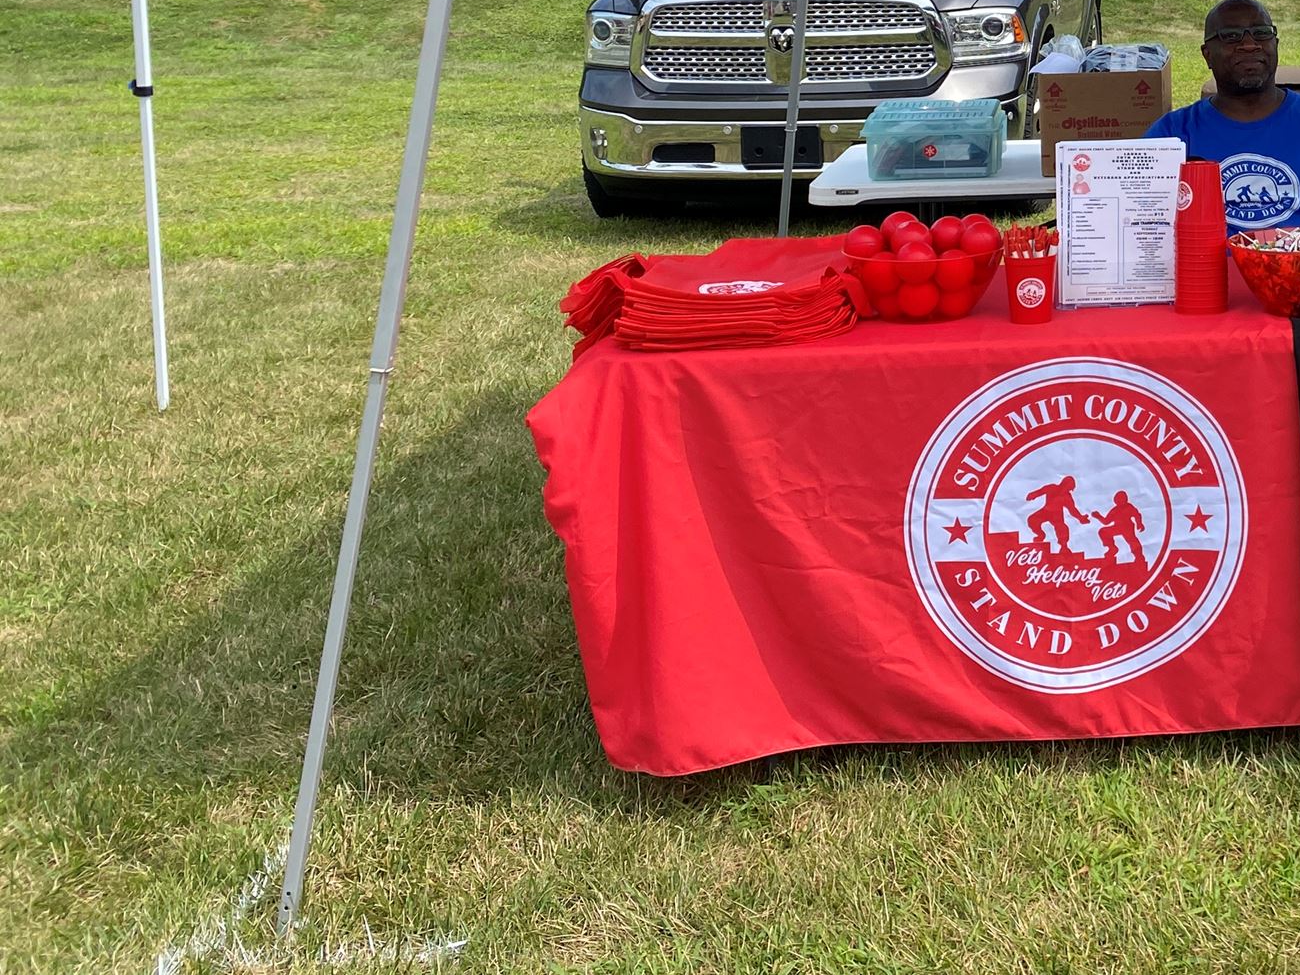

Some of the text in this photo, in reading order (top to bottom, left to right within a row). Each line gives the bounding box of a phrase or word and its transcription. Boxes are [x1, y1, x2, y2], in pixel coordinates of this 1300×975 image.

[1221, 163, 1288, 185] UMMIT COUNTY
[1225, 198, 1292, 219] TAND DOWN
[954, 394, 1203, 492] SUMMIT COUNTY
[1005, 547, 1043, 568] Vets
[1023, 565, 1103, 588] Helping
[1091, 581, 1128, 602] Vets
[955, 557, 1201, 655] STAND DOWN
